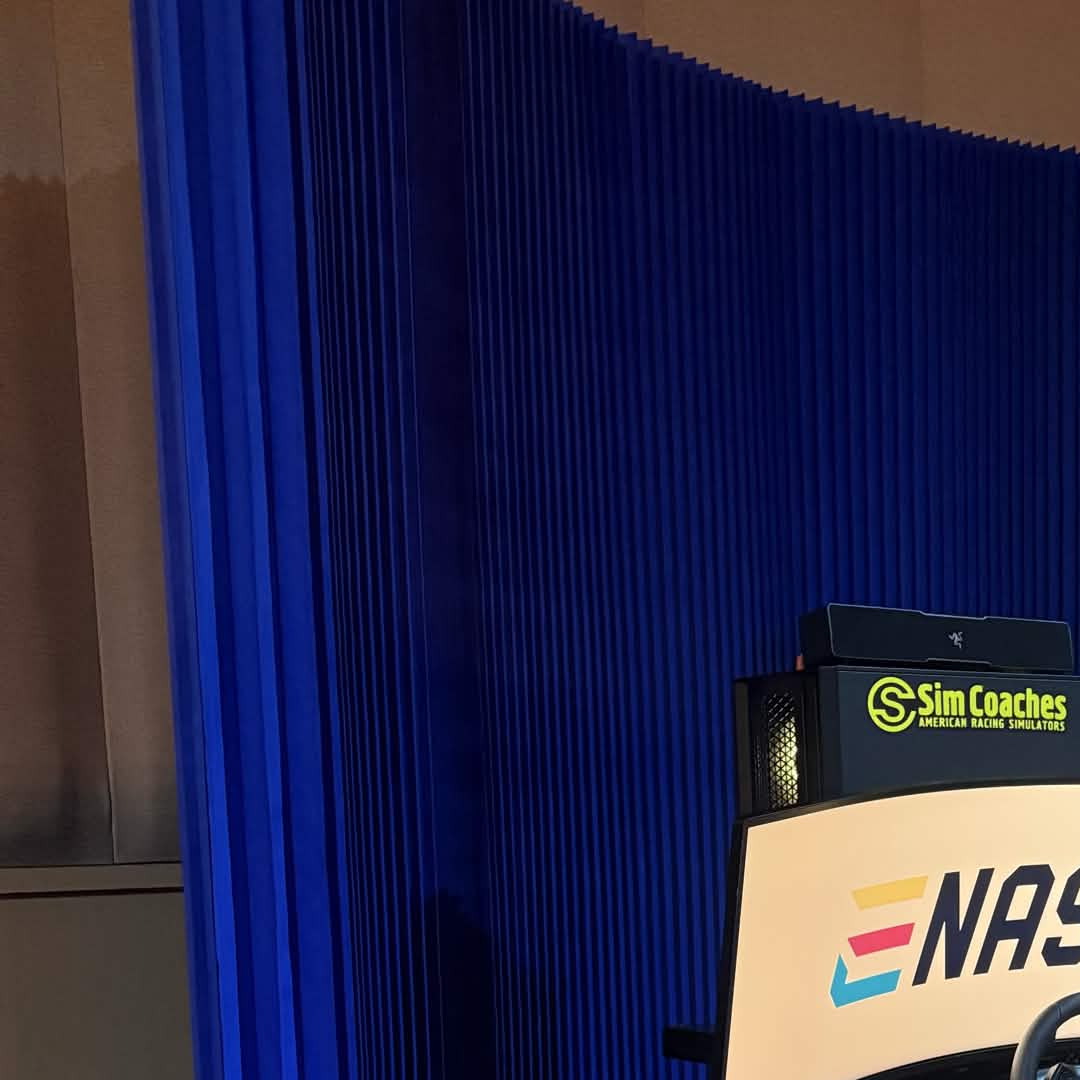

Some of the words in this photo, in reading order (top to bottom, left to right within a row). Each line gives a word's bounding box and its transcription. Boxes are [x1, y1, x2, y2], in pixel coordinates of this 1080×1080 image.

[917, 682, 965, 716] Sim
[969, 685, 1067, 721] Coaches
[919, 717, 966, 728] AMERICAN
[971, 718, 1004, 729] RACING
[1008, 719, 1065, 732] SIMULATORS
